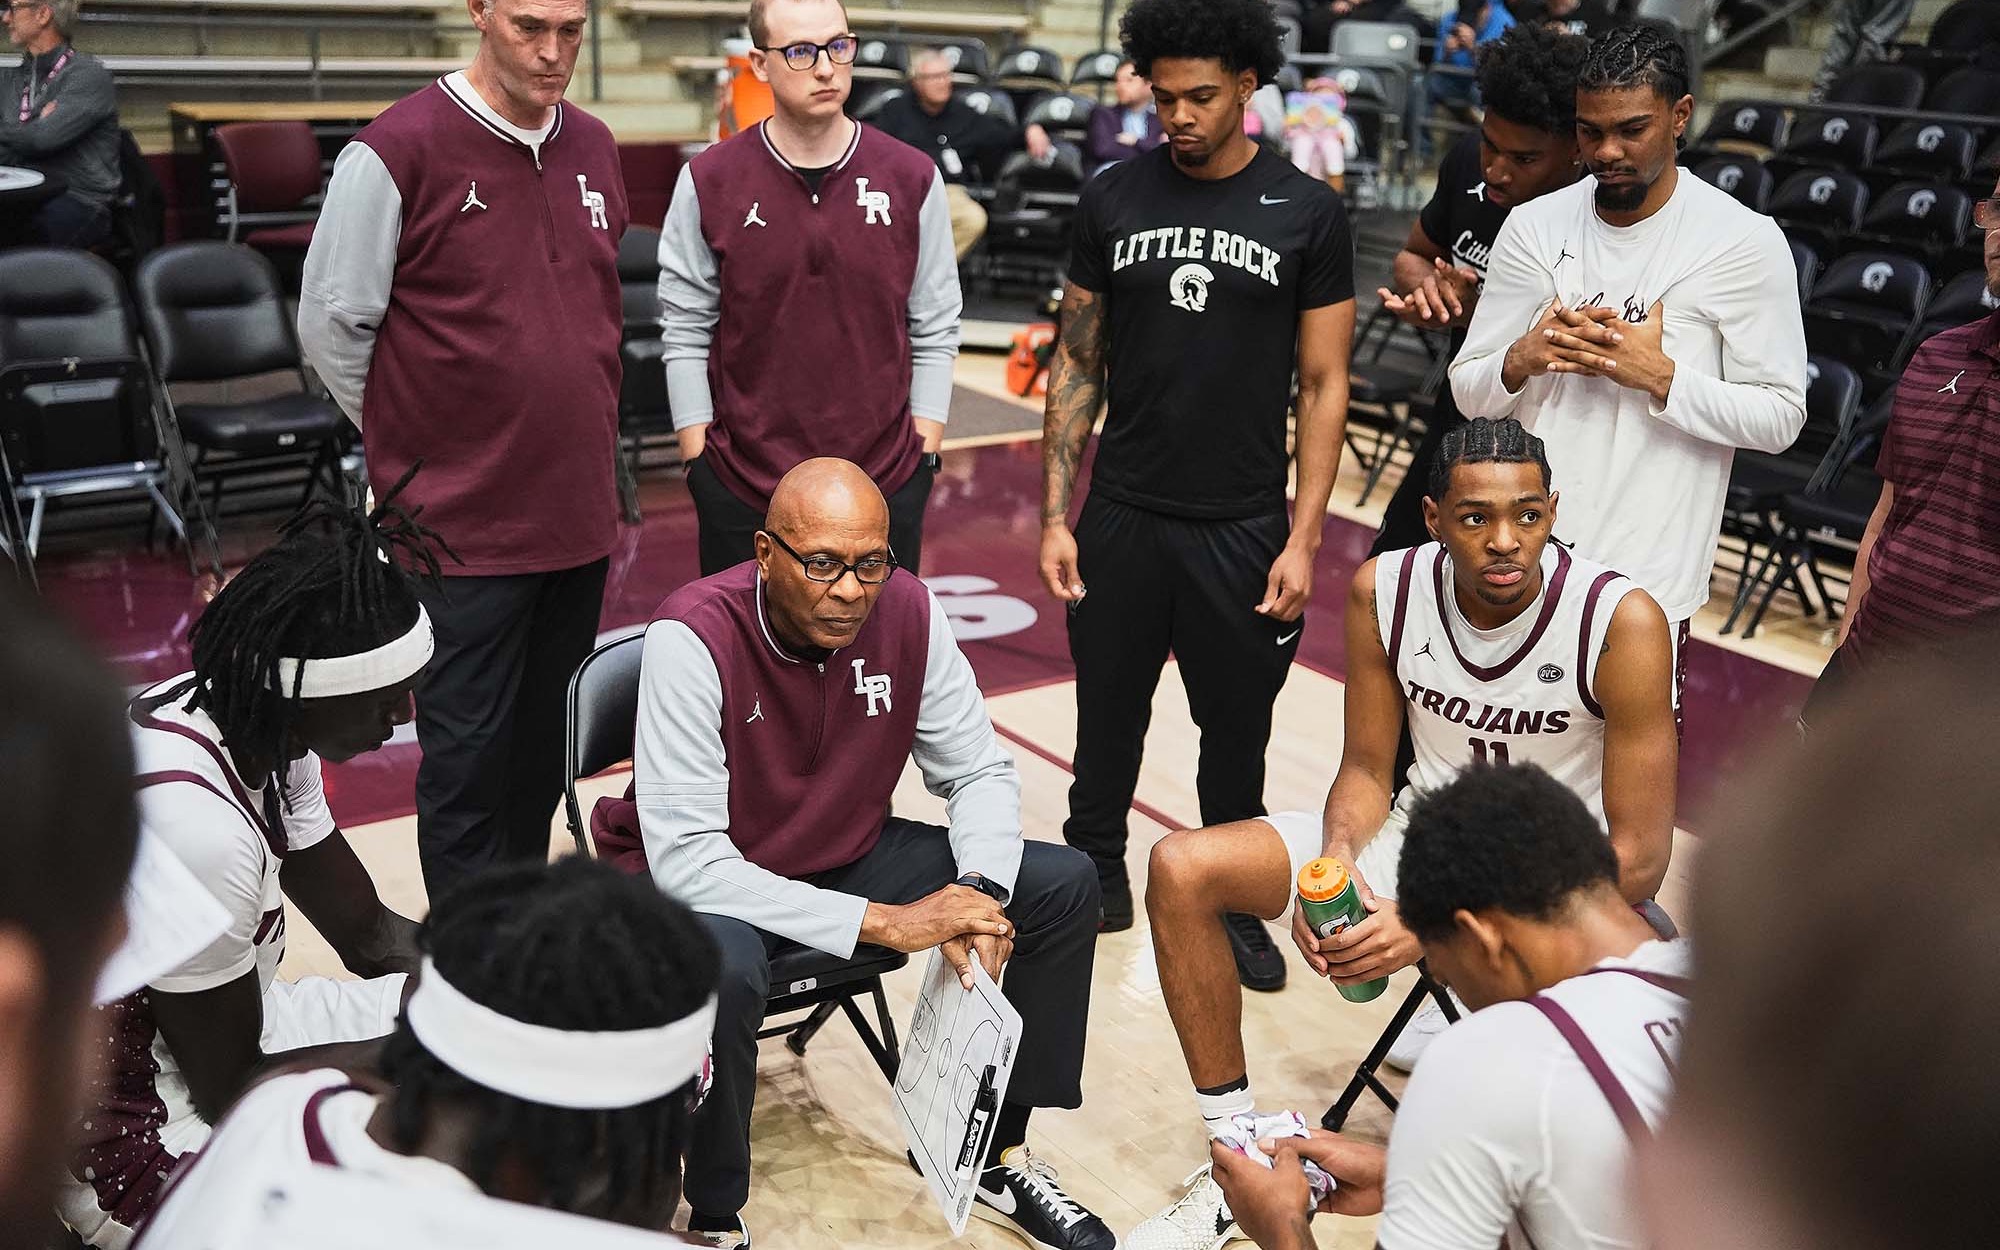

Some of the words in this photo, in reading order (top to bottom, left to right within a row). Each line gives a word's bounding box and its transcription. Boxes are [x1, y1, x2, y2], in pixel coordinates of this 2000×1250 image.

[576, 174, 609, 230] LR
[855, 177, 892, 226] LR
[1112, 226, 1206, 272] LITTLE
[1210, 229, 1281, 287] ROCK
[851, 658, 892, 716] LR
[1407, 679, 1571, 735] TROJANS
[1468, 737, 1510, 765] 11
[800, 981, 807, 990] 3
